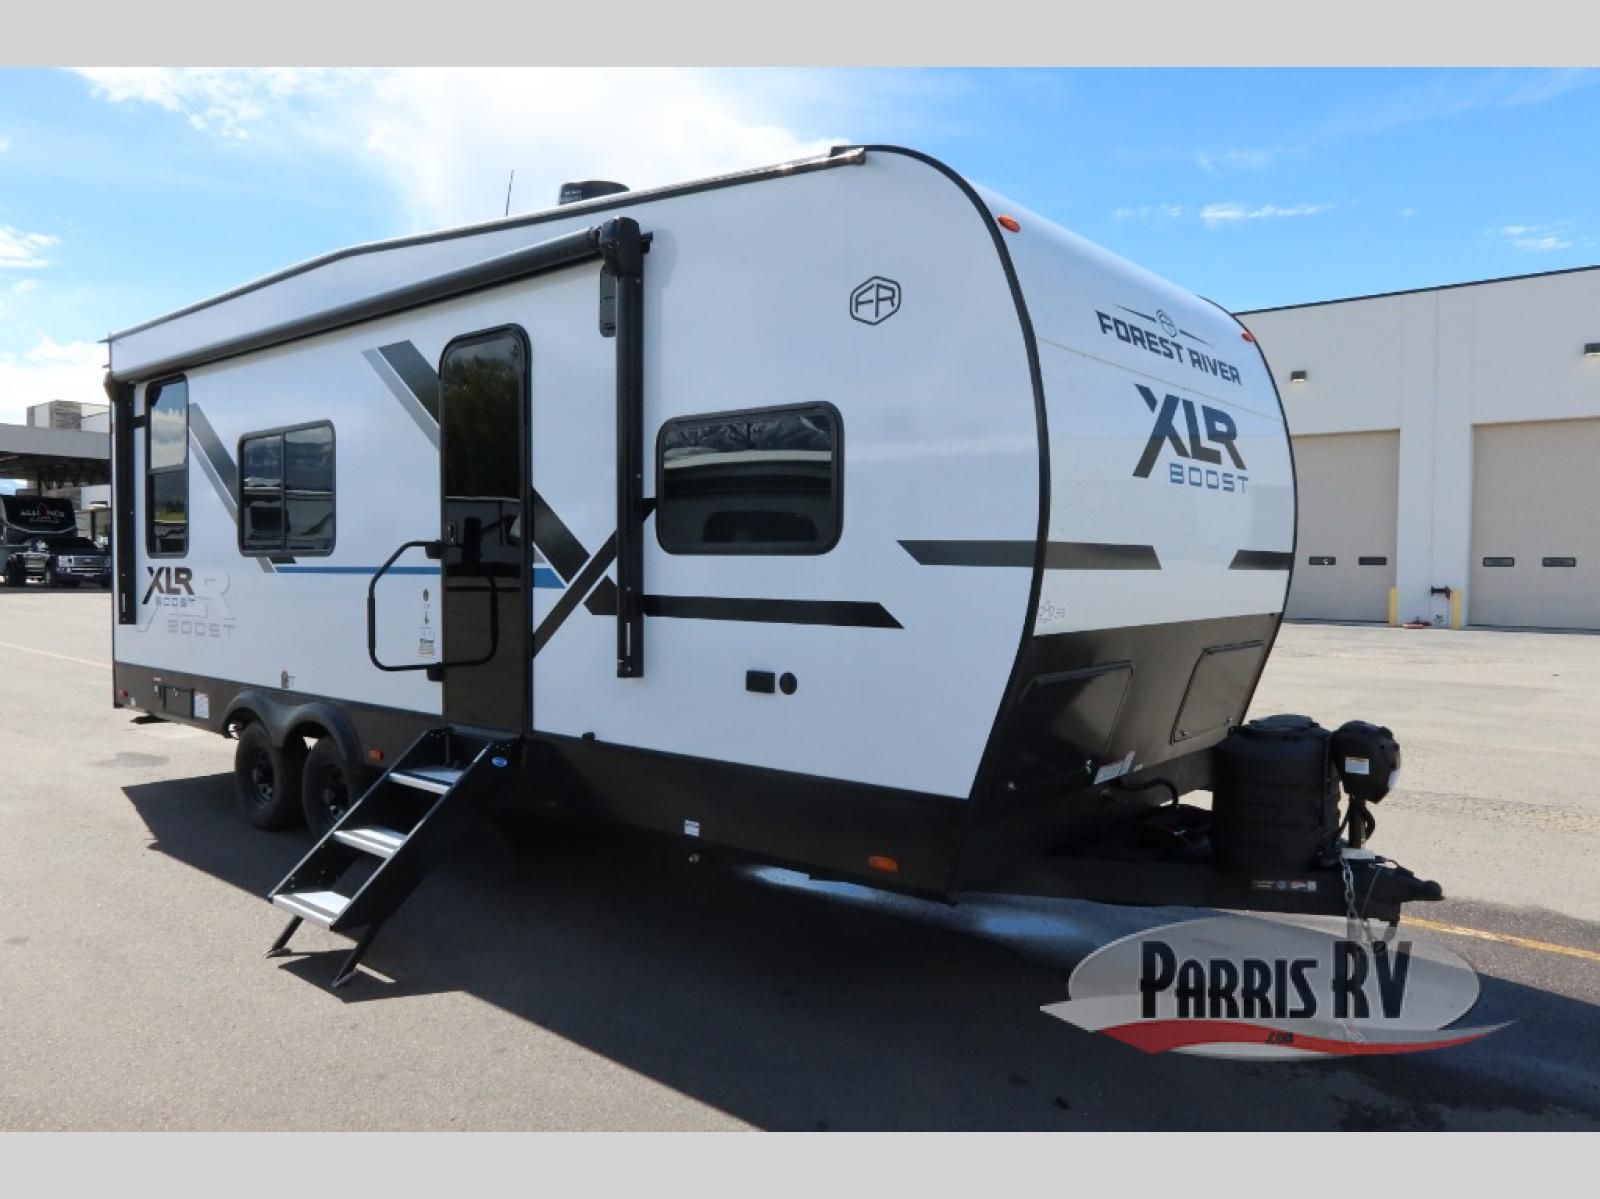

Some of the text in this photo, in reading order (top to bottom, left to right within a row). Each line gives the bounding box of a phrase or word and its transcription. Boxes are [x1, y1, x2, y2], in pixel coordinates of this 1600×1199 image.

[855, 283, 896, 319] FR
[1095, 310, 1242, 386] FOREST RIVER
[1132, 383, 1247, 479] XLR
[1169, 462, 1248, 494] BOOST
[142, 566, 195, 605] XLR
[168, 620, 235, 640] BOOST
